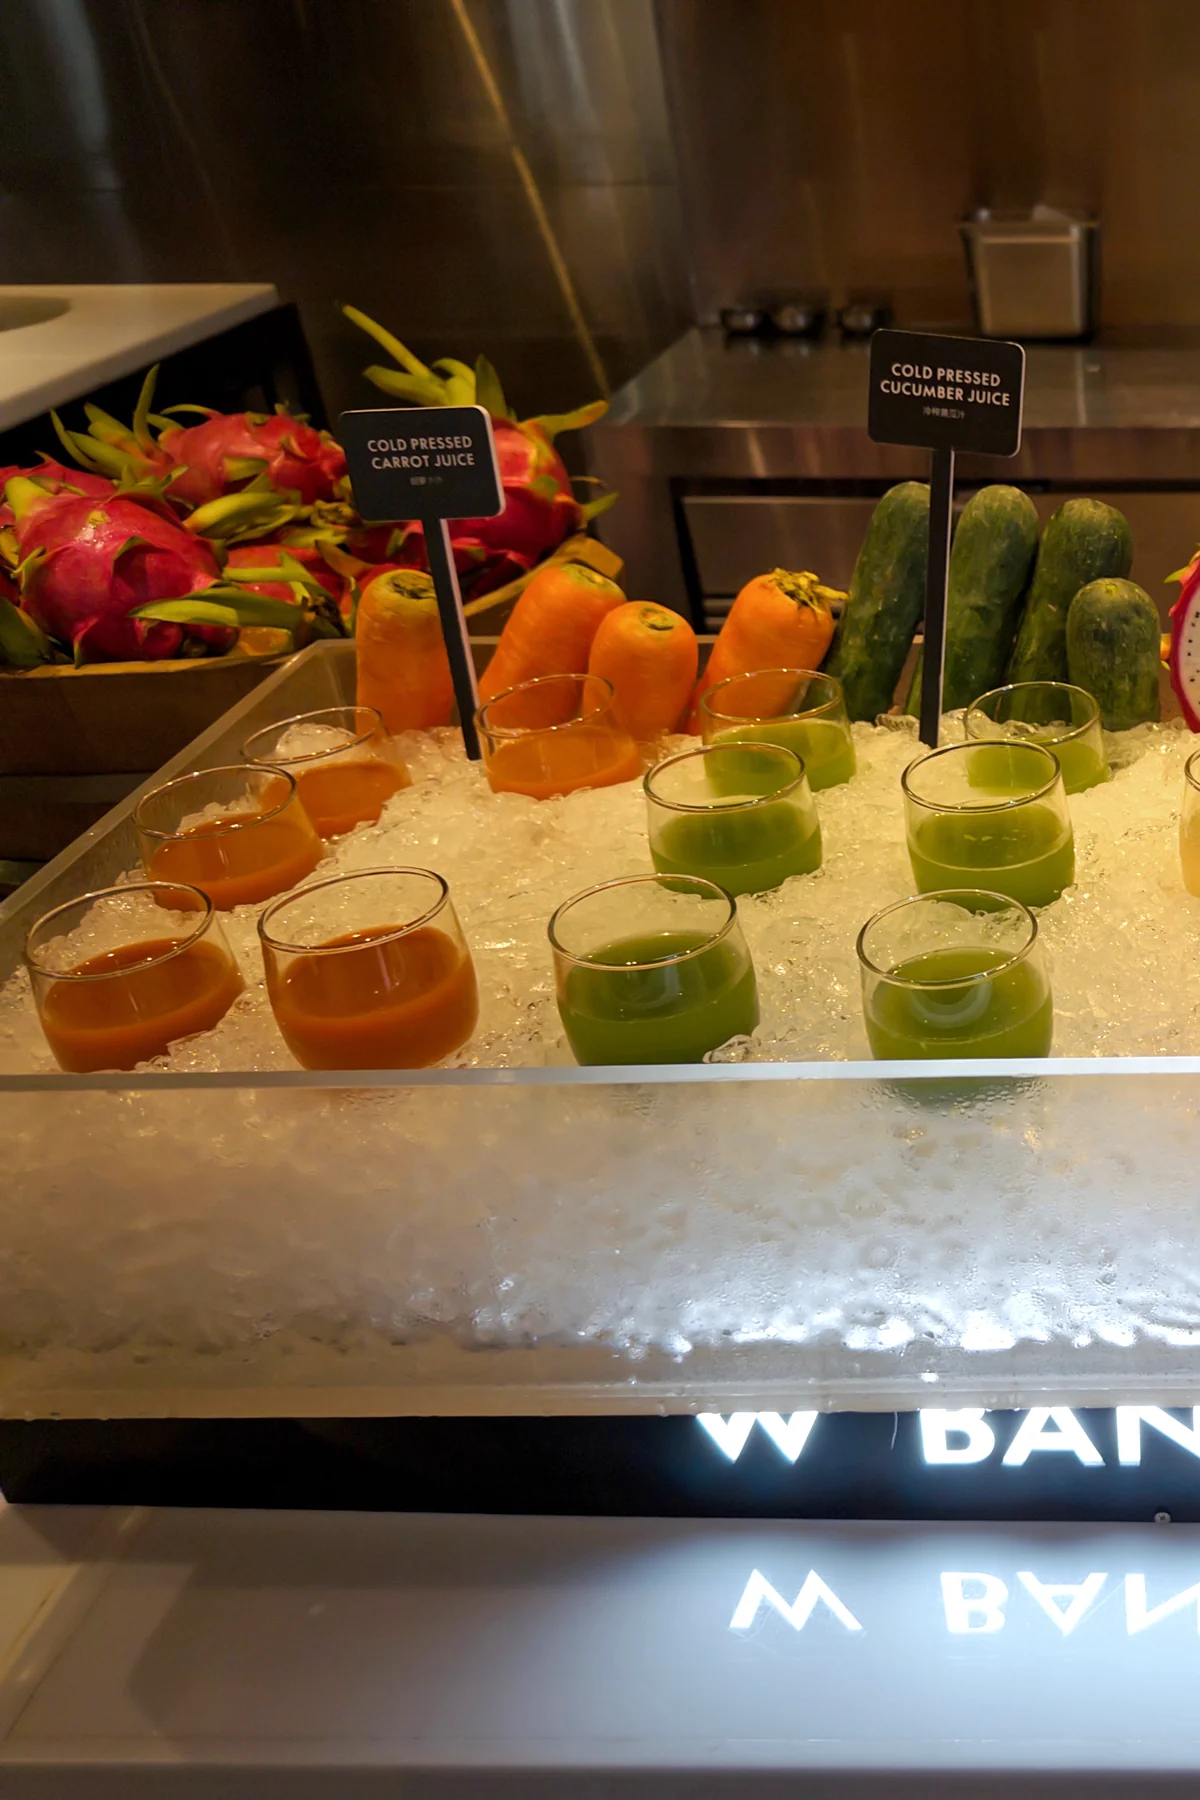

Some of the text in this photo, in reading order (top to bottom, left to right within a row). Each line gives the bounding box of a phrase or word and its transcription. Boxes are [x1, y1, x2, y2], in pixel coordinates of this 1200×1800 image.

[891, 363, 1001, 387] COLD PRESSED
[880, 380, 1011, 407] CUCUMBER JUICE
[367, 436, 473, 453] COLD PRESSED
[371, 453, 476, 470] CARROT JUICE
[695, 1410, 819, 1464] W
